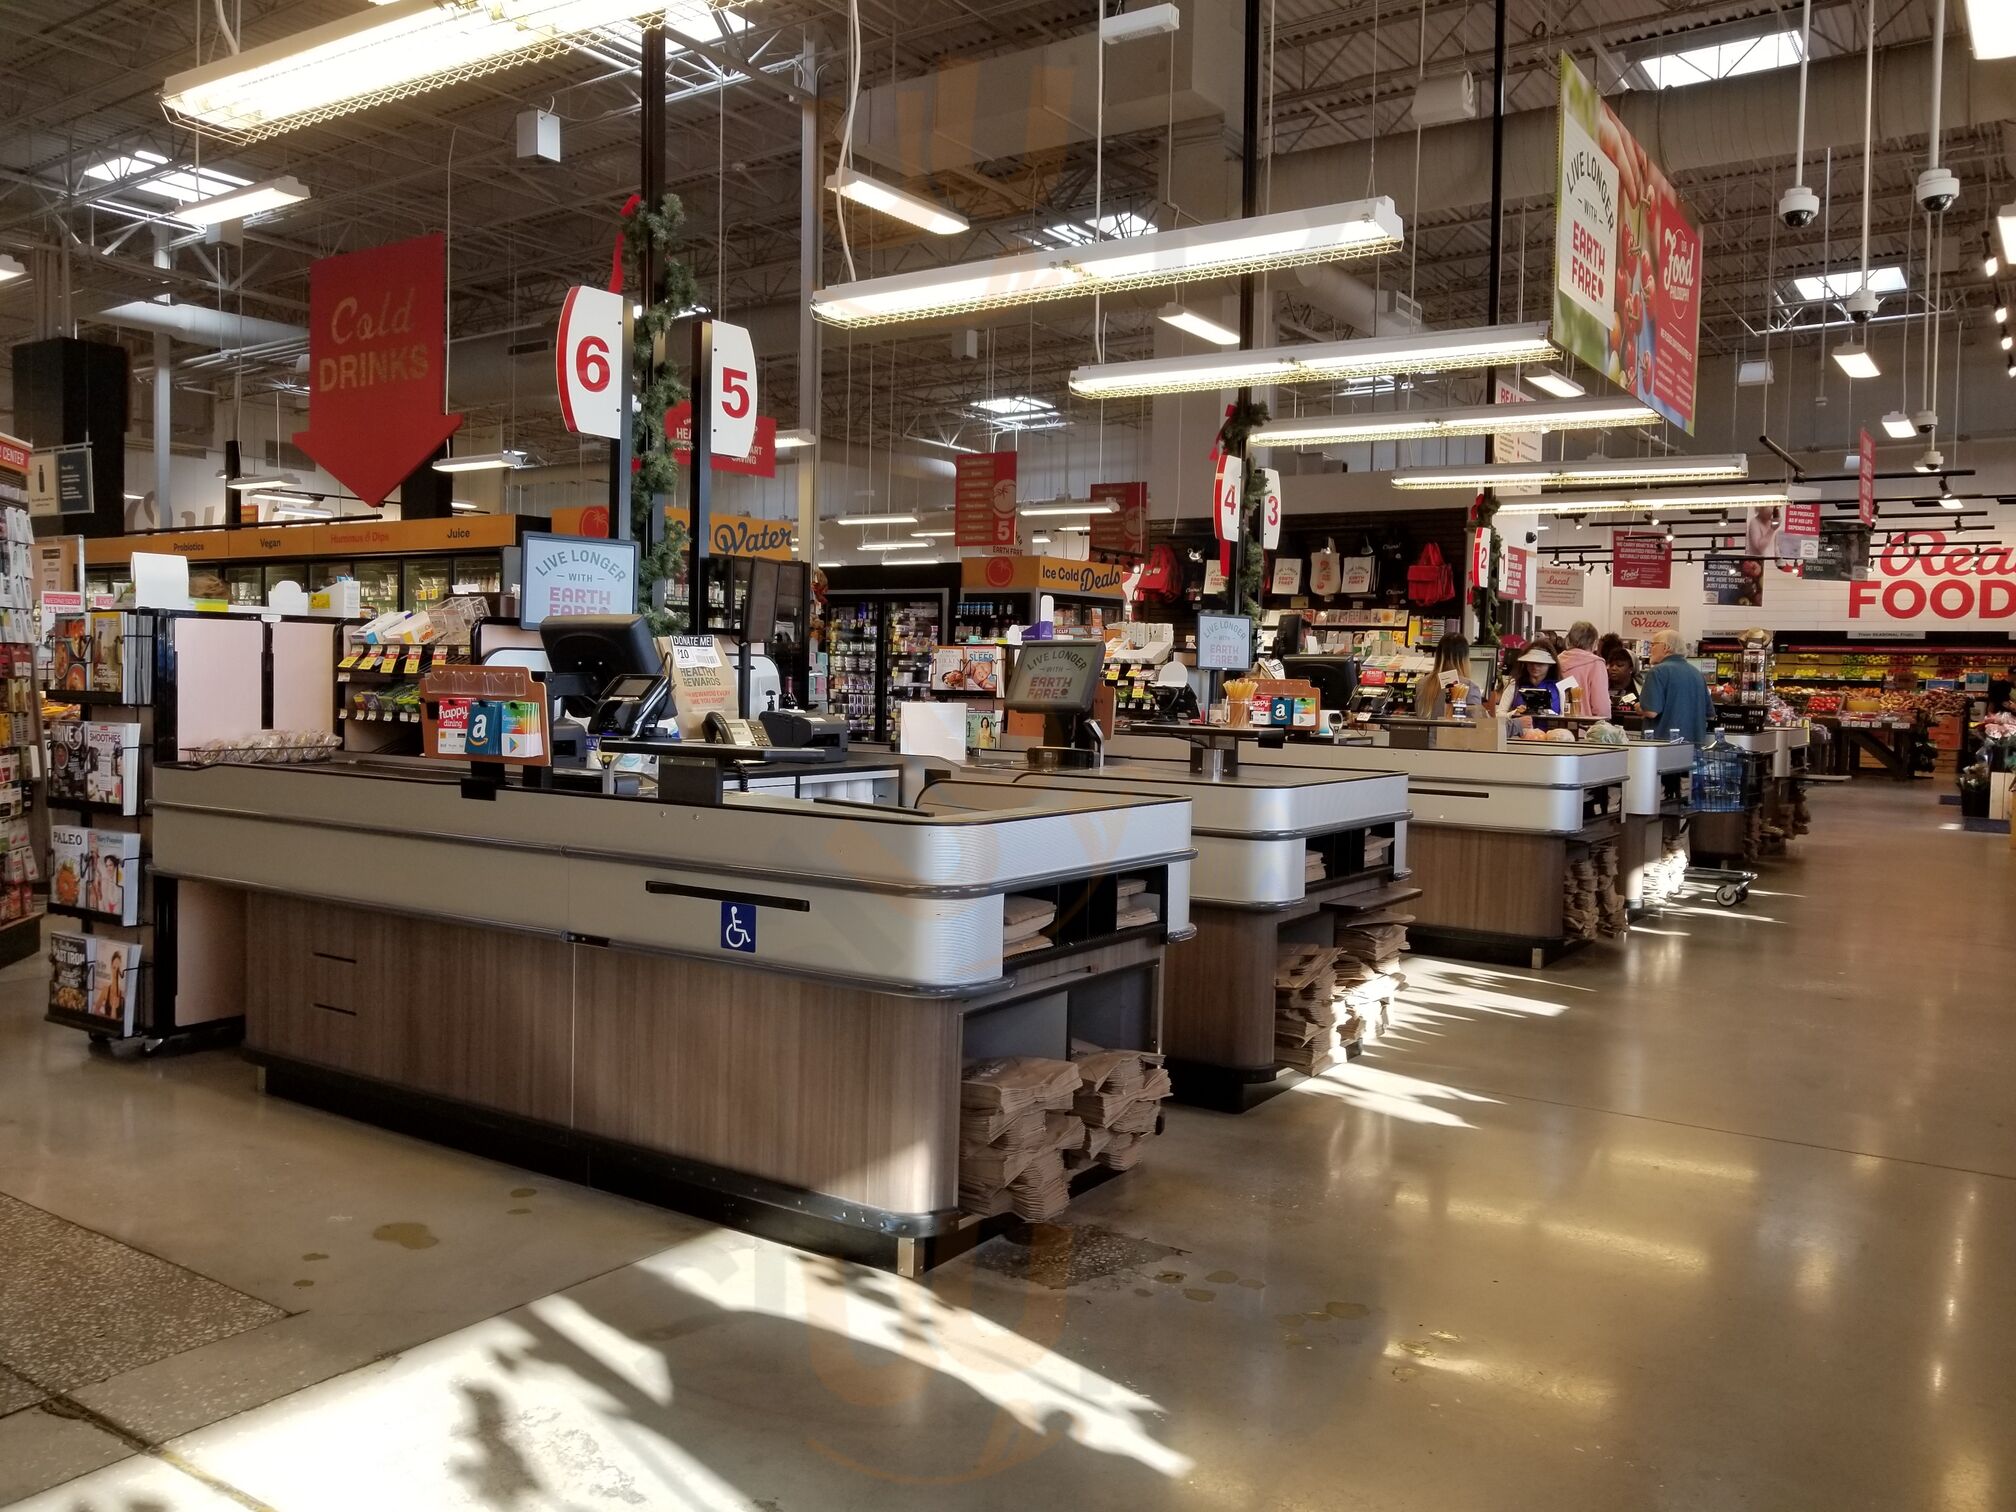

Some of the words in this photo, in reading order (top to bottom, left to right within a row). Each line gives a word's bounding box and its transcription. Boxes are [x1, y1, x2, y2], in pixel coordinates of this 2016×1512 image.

[1566, 151, 1585, 194] LIVE
[1587, 151, 1614, 234] LONGER
[1584, 198, 1598, 224] WITH
[1572, 219, 1606, 275] EARTH
[1663, 227, 1695, 291] Food
[1571, 254, 1597, 302] FARE
[331, 287, 416, 344] Cold
[319, 343, 429, 392] DRINKS
[576, 336, 610, 392] 6
[722, 367, 750, 419] 5
[2, 446, 24, 466] CENTER
[1224, 484, 1236, 516] 4
[1268, 496, 1278, 526] 3
[330, 534, 364, 545] Hummus
[372, 531, 390, 544] Dips
[447, 528, 470, 539] Juice
[714, 522, 793, 555] Water
[997, 520, 1010, 541] 5
[173, 543, 204, 552] Probiotics
[260, 538, 281, 548] Vegan
[536, 551, 568, 577] LIVE
[571, 549, 626, 582] LONGER
[1480, 547, 1488, 569] 2
[1500, 554, 1506, 574] 1
[568, 573, 593, 582] WITH
[1042, 565, 1056, 579] Ice
[1058, 568, 1079, 582] Cold
[1080, 565, 1120, 592] Deals
[1546, 576, 1570, 586] Local
[1620, 568, 1640, 580] Food
[549, 586, 611, 606] EARTH
[1848, 579, 2016, 619] FOOD
[1203, 622, 1219, 639] LIVE
[1220, 620, 1246, 641] LONGER
[1630, 617, 1670, 628] Water
[674, 636, 698, 646] DONATE
[700, 635, 712, 646] ME!
[1210, 644, 1240, 655] EARTH
[1027, 653, 1050, 671] LIVE
[1052, 650, 1087, 671] LONGER
[1210, 655, 1232, 664] FARE
[680, 667, 716, 677] HEALTHY
[1031, 676, 1072, 688] EARTH
[683, 678, 721, 687] REWARDS
[1027, 688, 1060, 699] FARE
[439, 705, 468, 720] happy
[1275, 703, 1286, 717] a
[444, 720, 462, 728] dining
[472, 714, 487, 738] a
[90, 732, 120, 743] SMOOTHIES
[53, 832, 82, 846] PALEO
